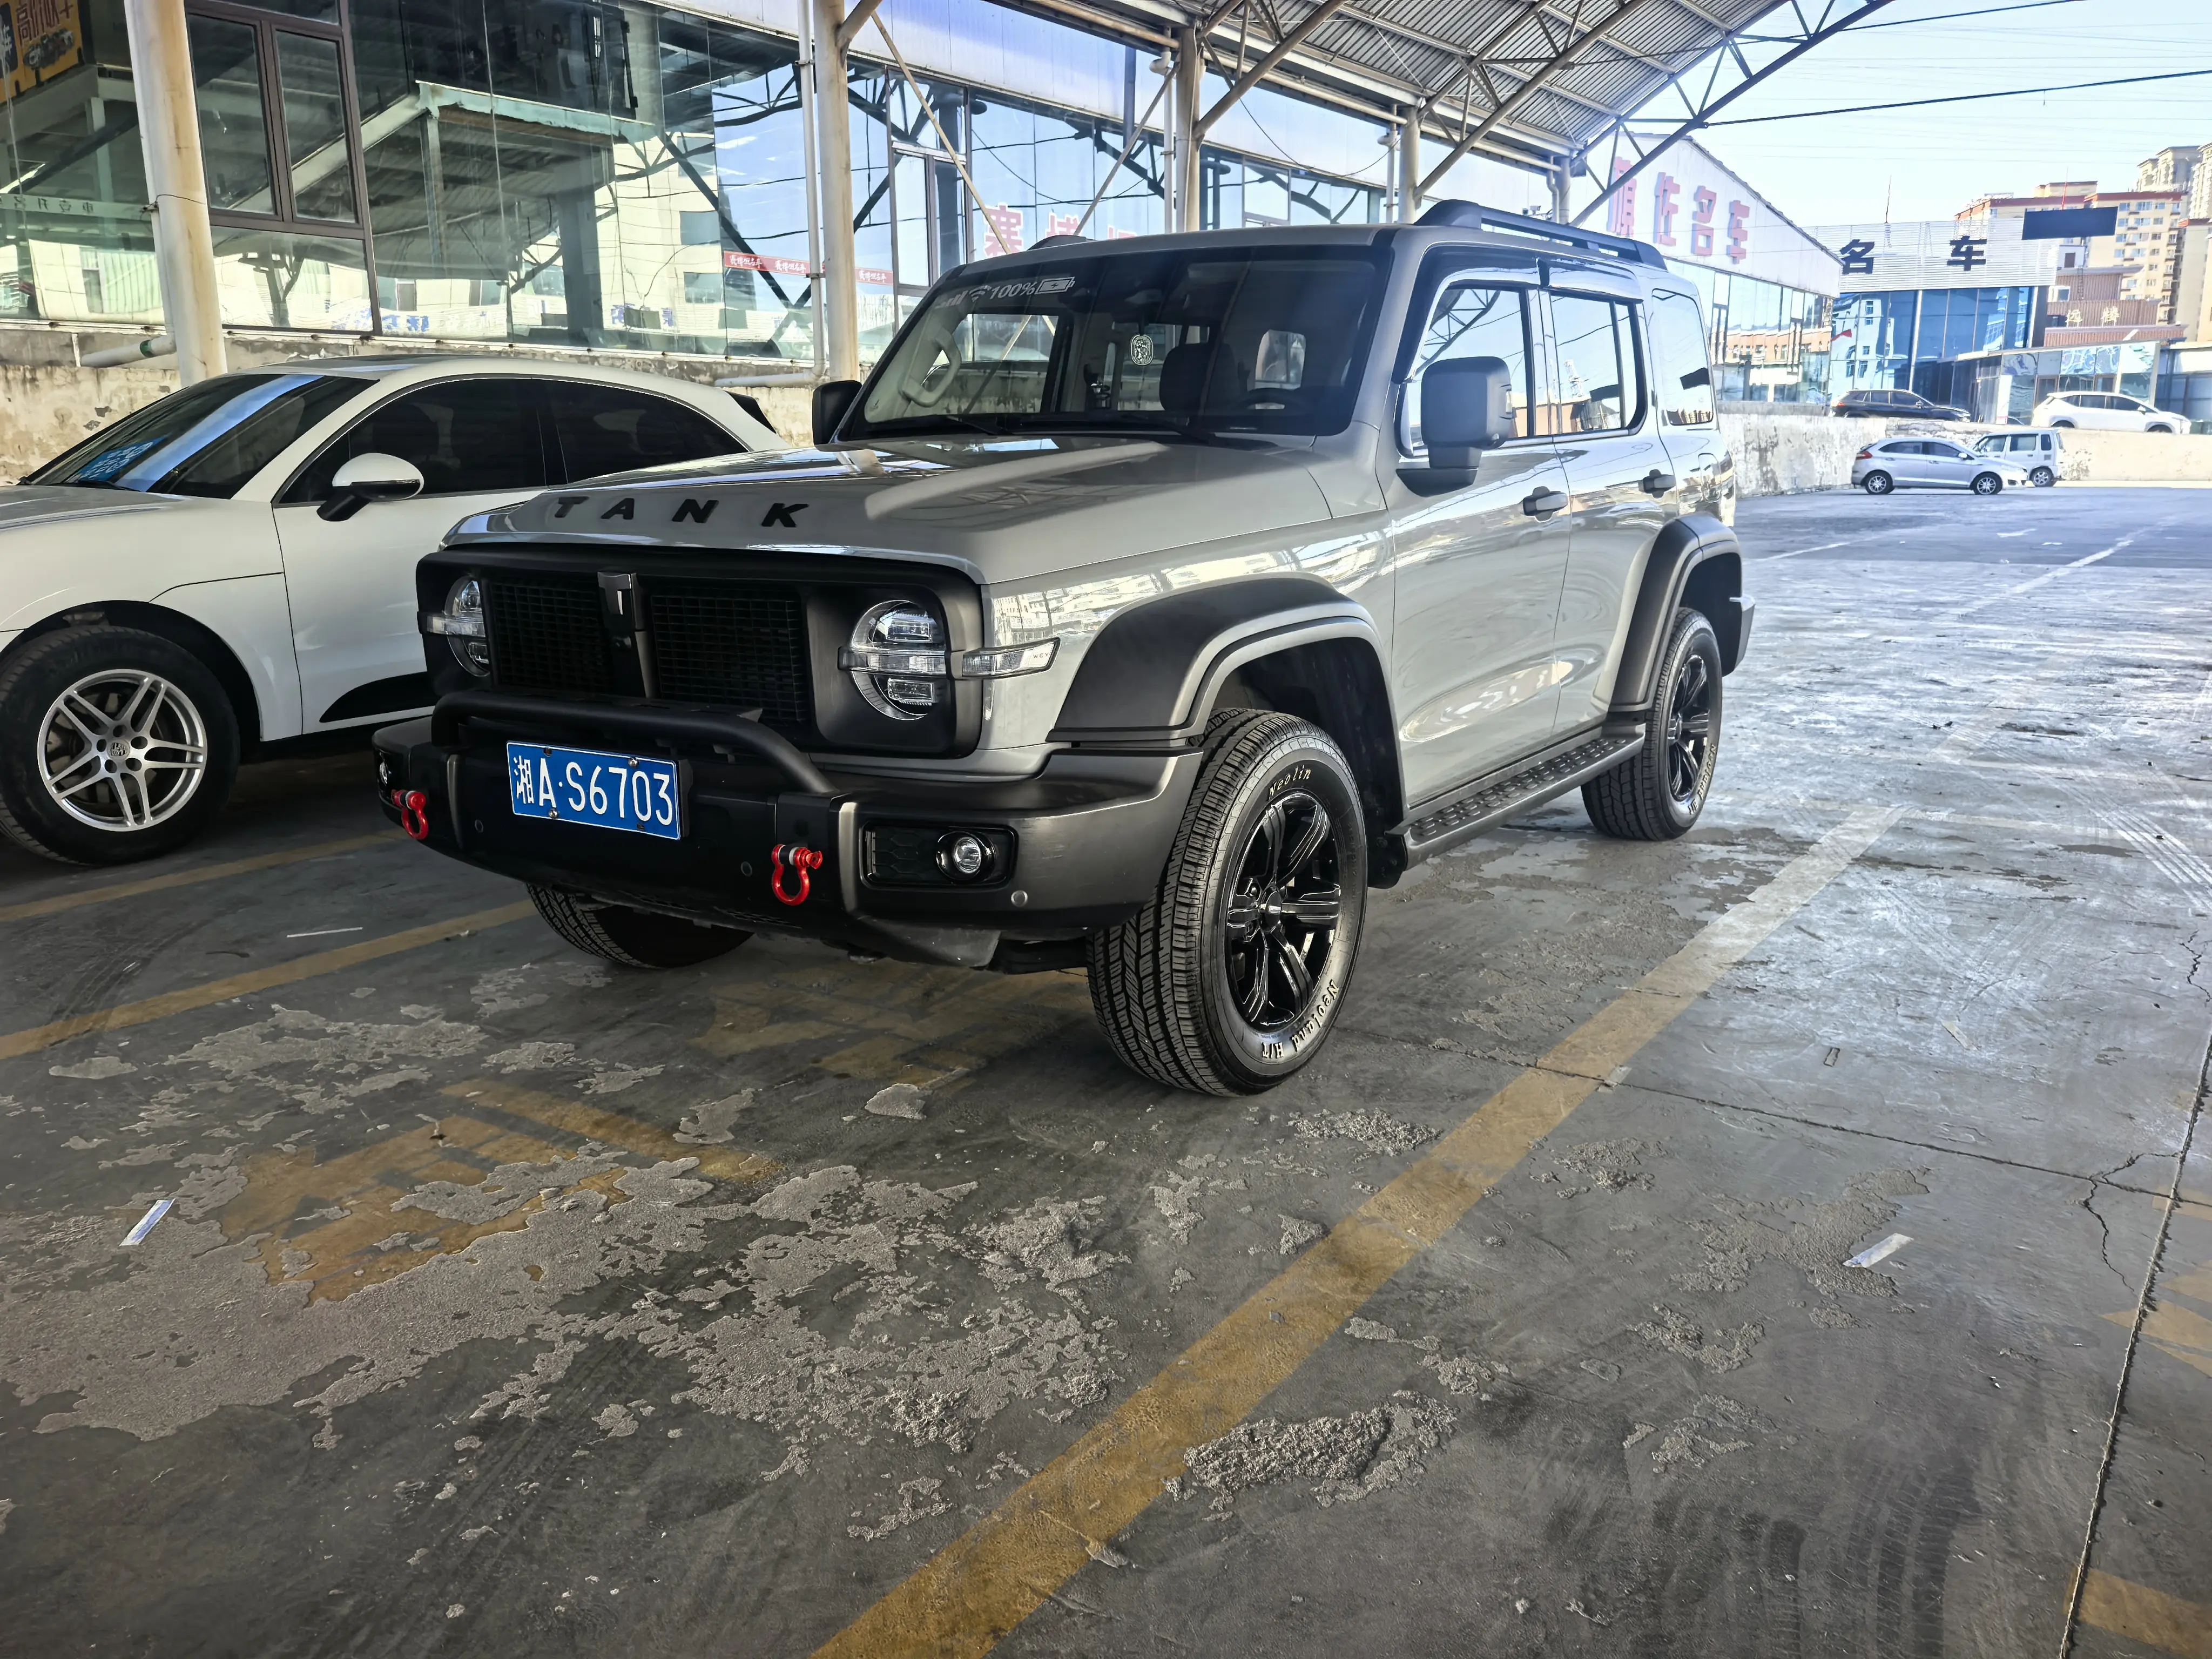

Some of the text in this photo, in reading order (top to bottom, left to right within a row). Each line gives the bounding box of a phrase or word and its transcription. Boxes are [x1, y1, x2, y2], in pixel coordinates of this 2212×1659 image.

[990, 282, 1038, 300] 100%
[554, 496, 809, 528] TANK
[1269, 765, 1311, 800] Neolin
[1262, 979, 1339, 1059] Neoland H/T
